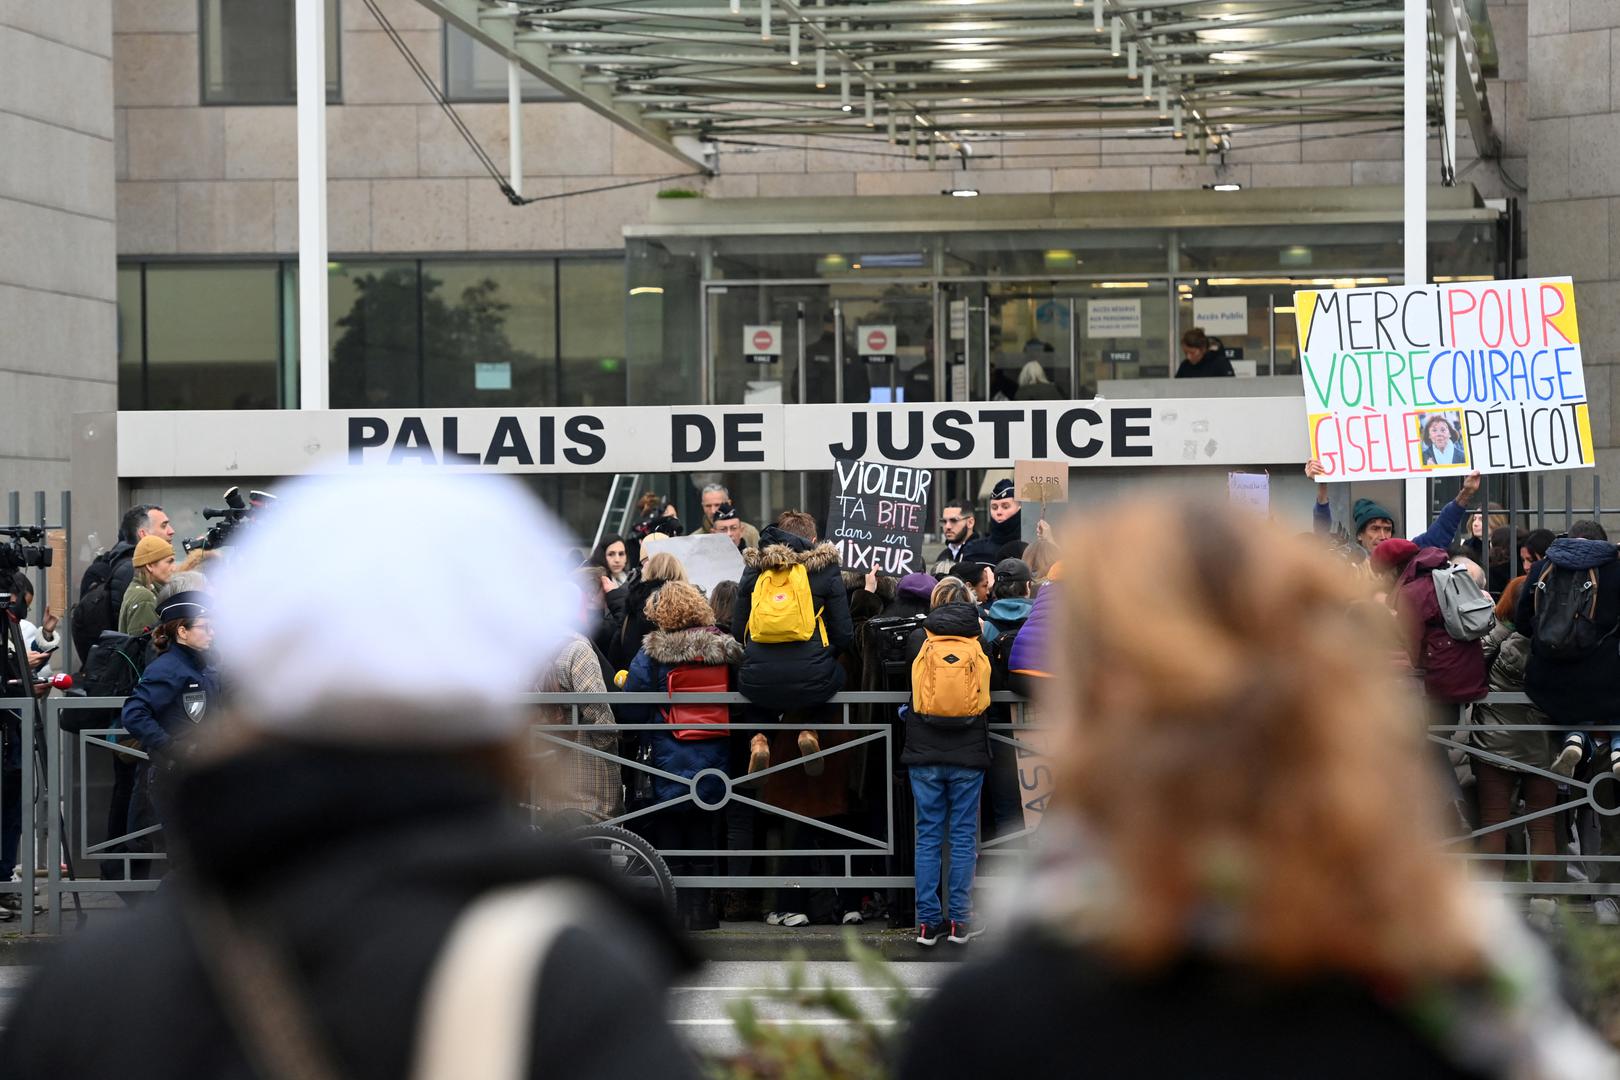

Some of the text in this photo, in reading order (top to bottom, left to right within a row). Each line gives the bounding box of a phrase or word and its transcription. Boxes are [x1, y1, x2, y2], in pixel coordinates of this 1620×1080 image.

[1221, 312, 1244, 320] Public
[1304, 284, 1573, 352] MERCI POUR
[1303, 347, 1583, 408] VOTRE COURAGE
[348, 408, 1152, 465] PALAIS DE JUSTICE
[1464, 402, 1587, 470] PÉLICOT
[836, 460, 932, 505] VIOLEUR
[834, 519, 911, 548] dans un
[835, 495, 921, 529] TA BITE
